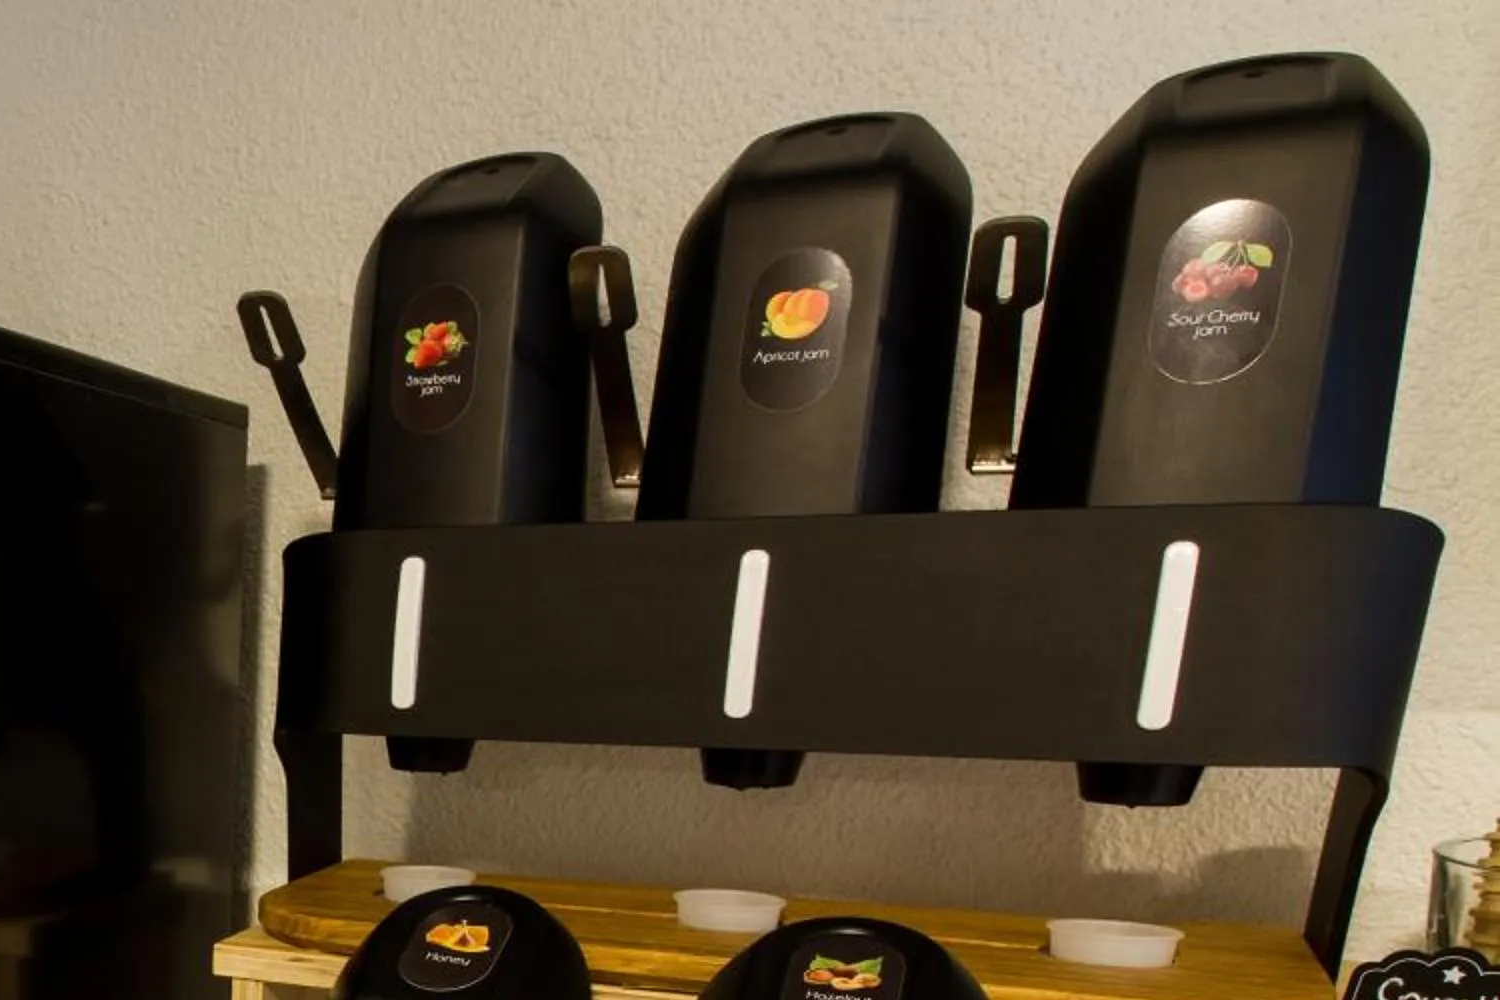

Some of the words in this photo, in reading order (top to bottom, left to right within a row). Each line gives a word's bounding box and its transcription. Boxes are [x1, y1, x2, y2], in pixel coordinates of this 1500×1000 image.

[1167, 312, 1205, 327] Sour
[1207, 309, 1261, 324] Cherry
[753, 350, 800, 365] Apricot
[425, 951, 472, 966] Honey
